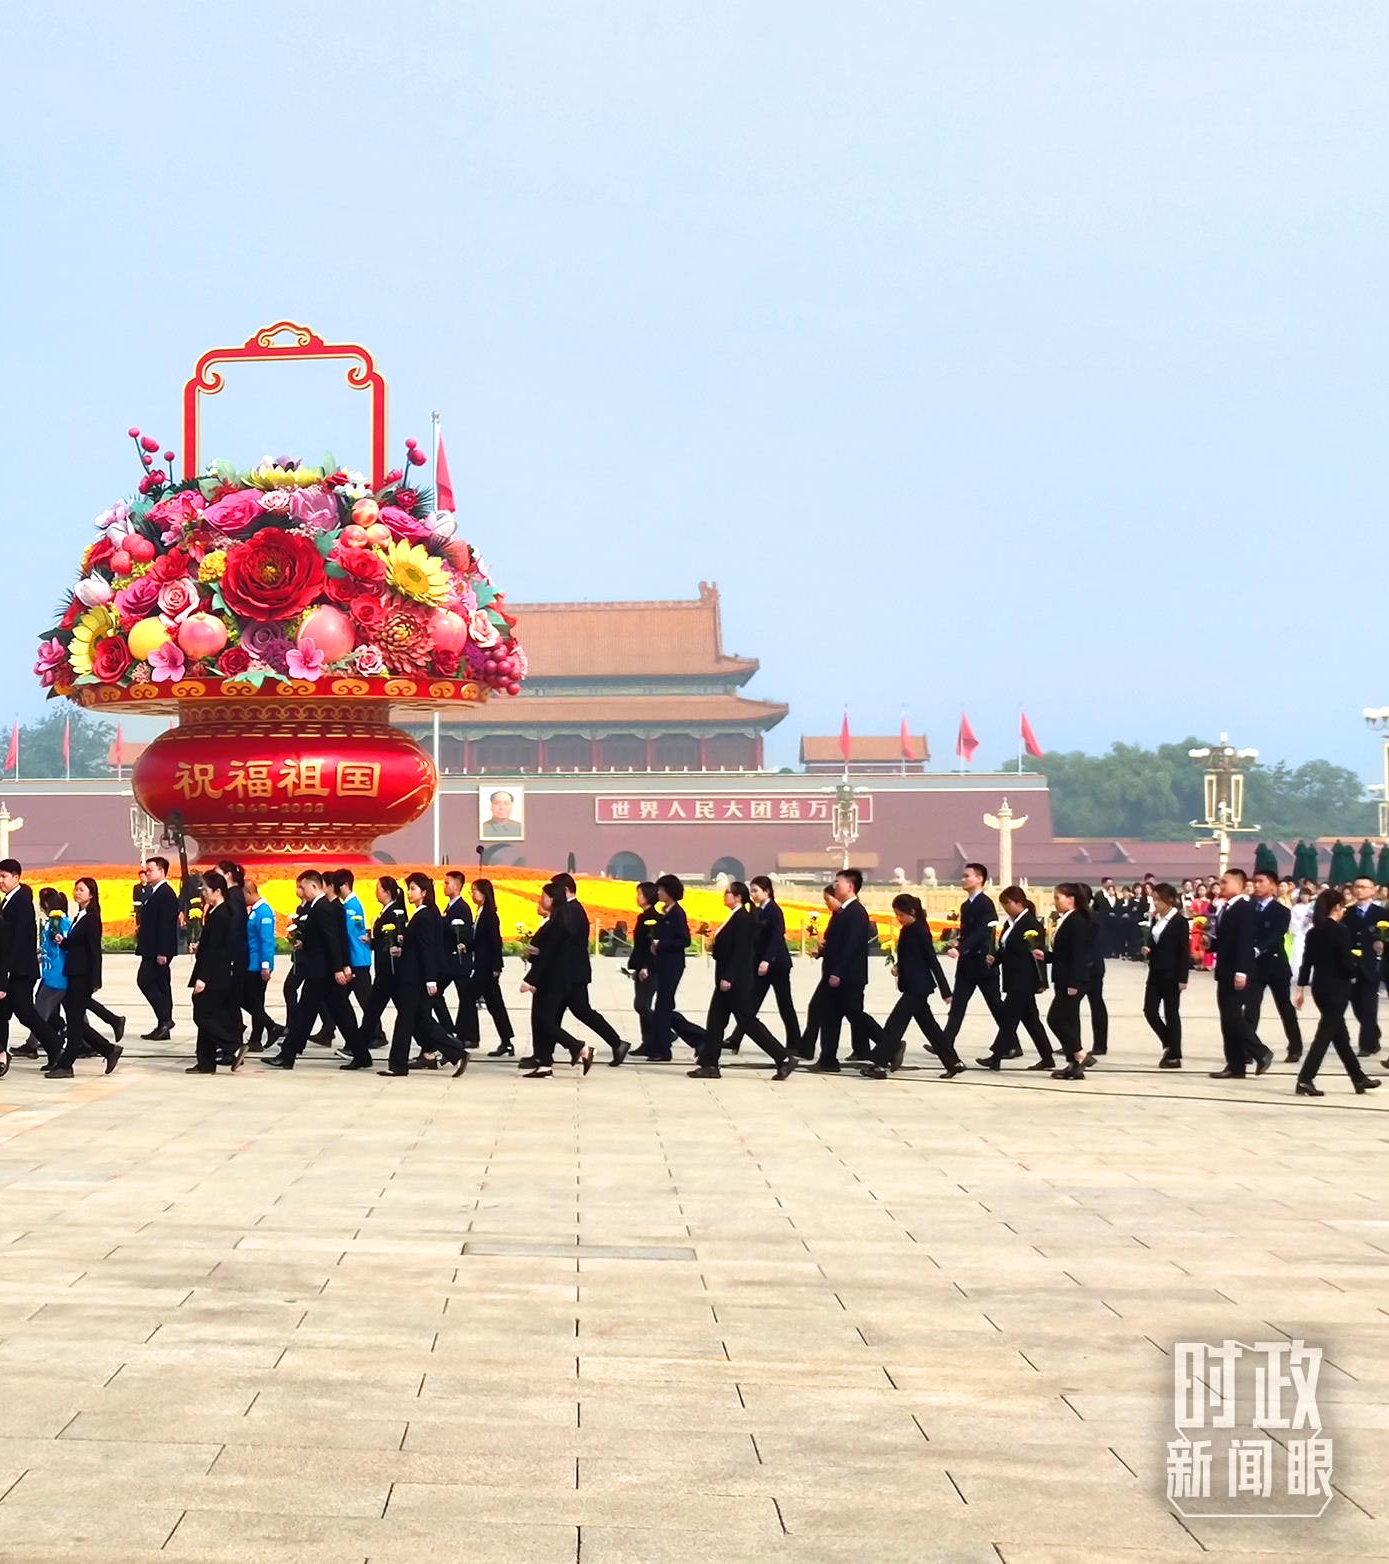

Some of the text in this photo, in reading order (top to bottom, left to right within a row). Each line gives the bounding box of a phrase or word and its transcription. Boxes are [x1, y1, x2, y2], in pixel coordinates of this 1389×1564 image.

[173, 759, 381, 799] 祝福祖国
[611, 800, 855, 819] 世界人民大团结万
